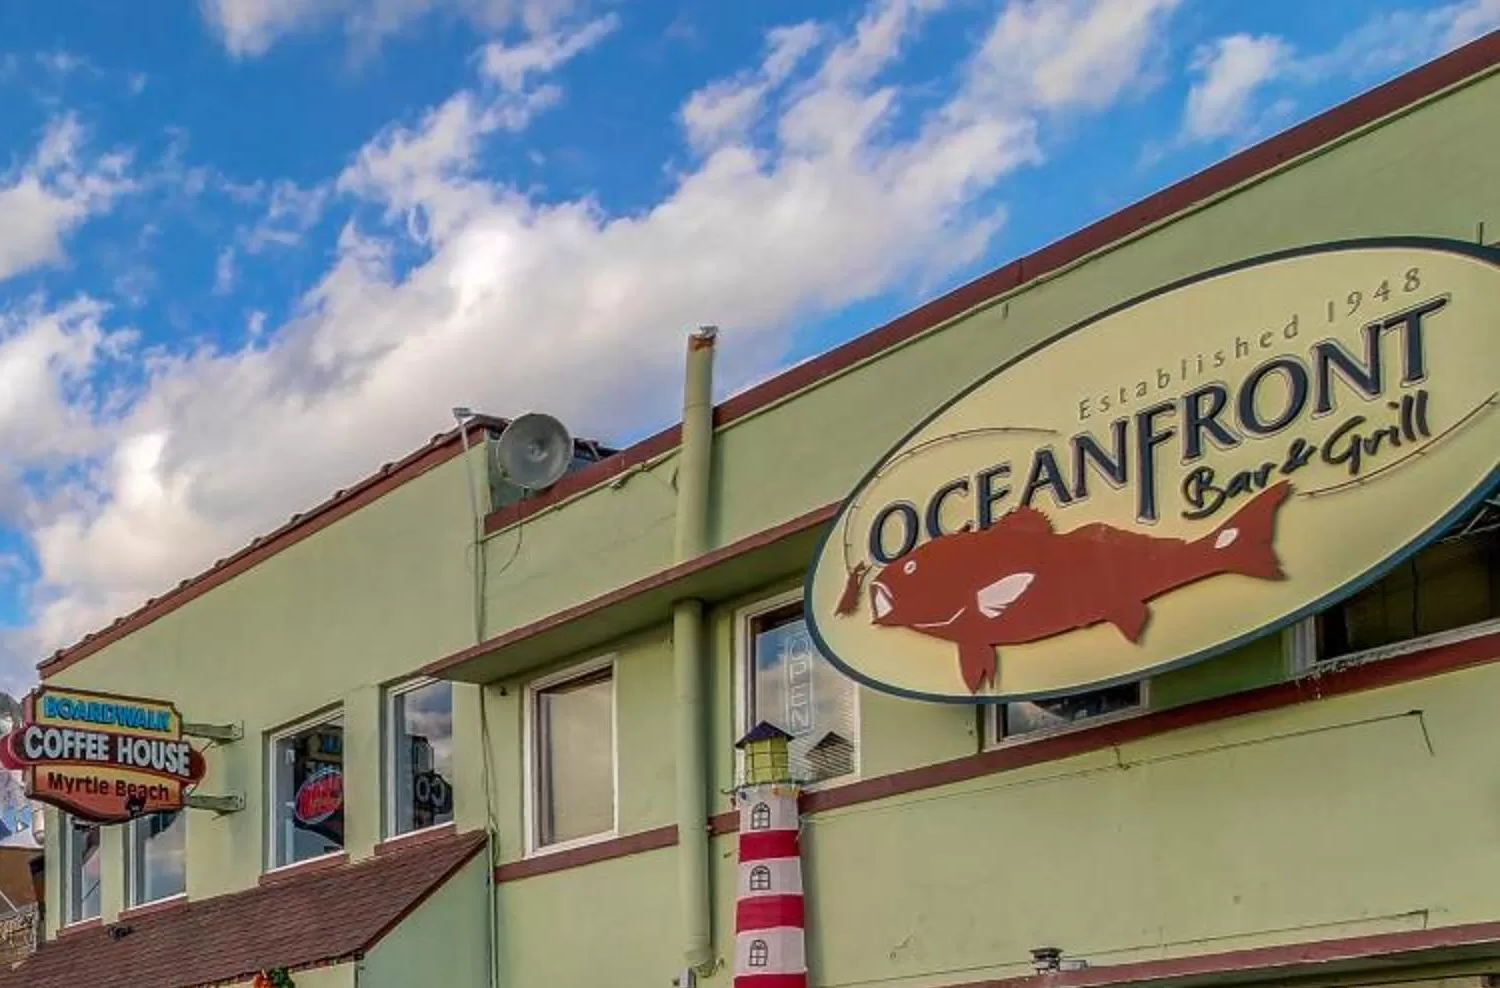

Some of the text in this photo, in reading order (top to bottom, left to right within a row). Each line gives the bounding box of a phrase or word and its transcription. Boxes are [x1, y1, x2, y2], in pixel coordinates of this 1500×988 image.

[1079, 267, 1421, 420] Established 1948
[869, 294, 1451, 565] OCEANFRONT
[1182, 390, 1430, 520] Bar & Grill
[43, 695, 171, 731] BOARDWALK
[790, 634, 810, 731] OPEN
[24, 725, 191, 776] COFFEE HOUSE
[47, 772, 169, 800] Myrtle Beach
